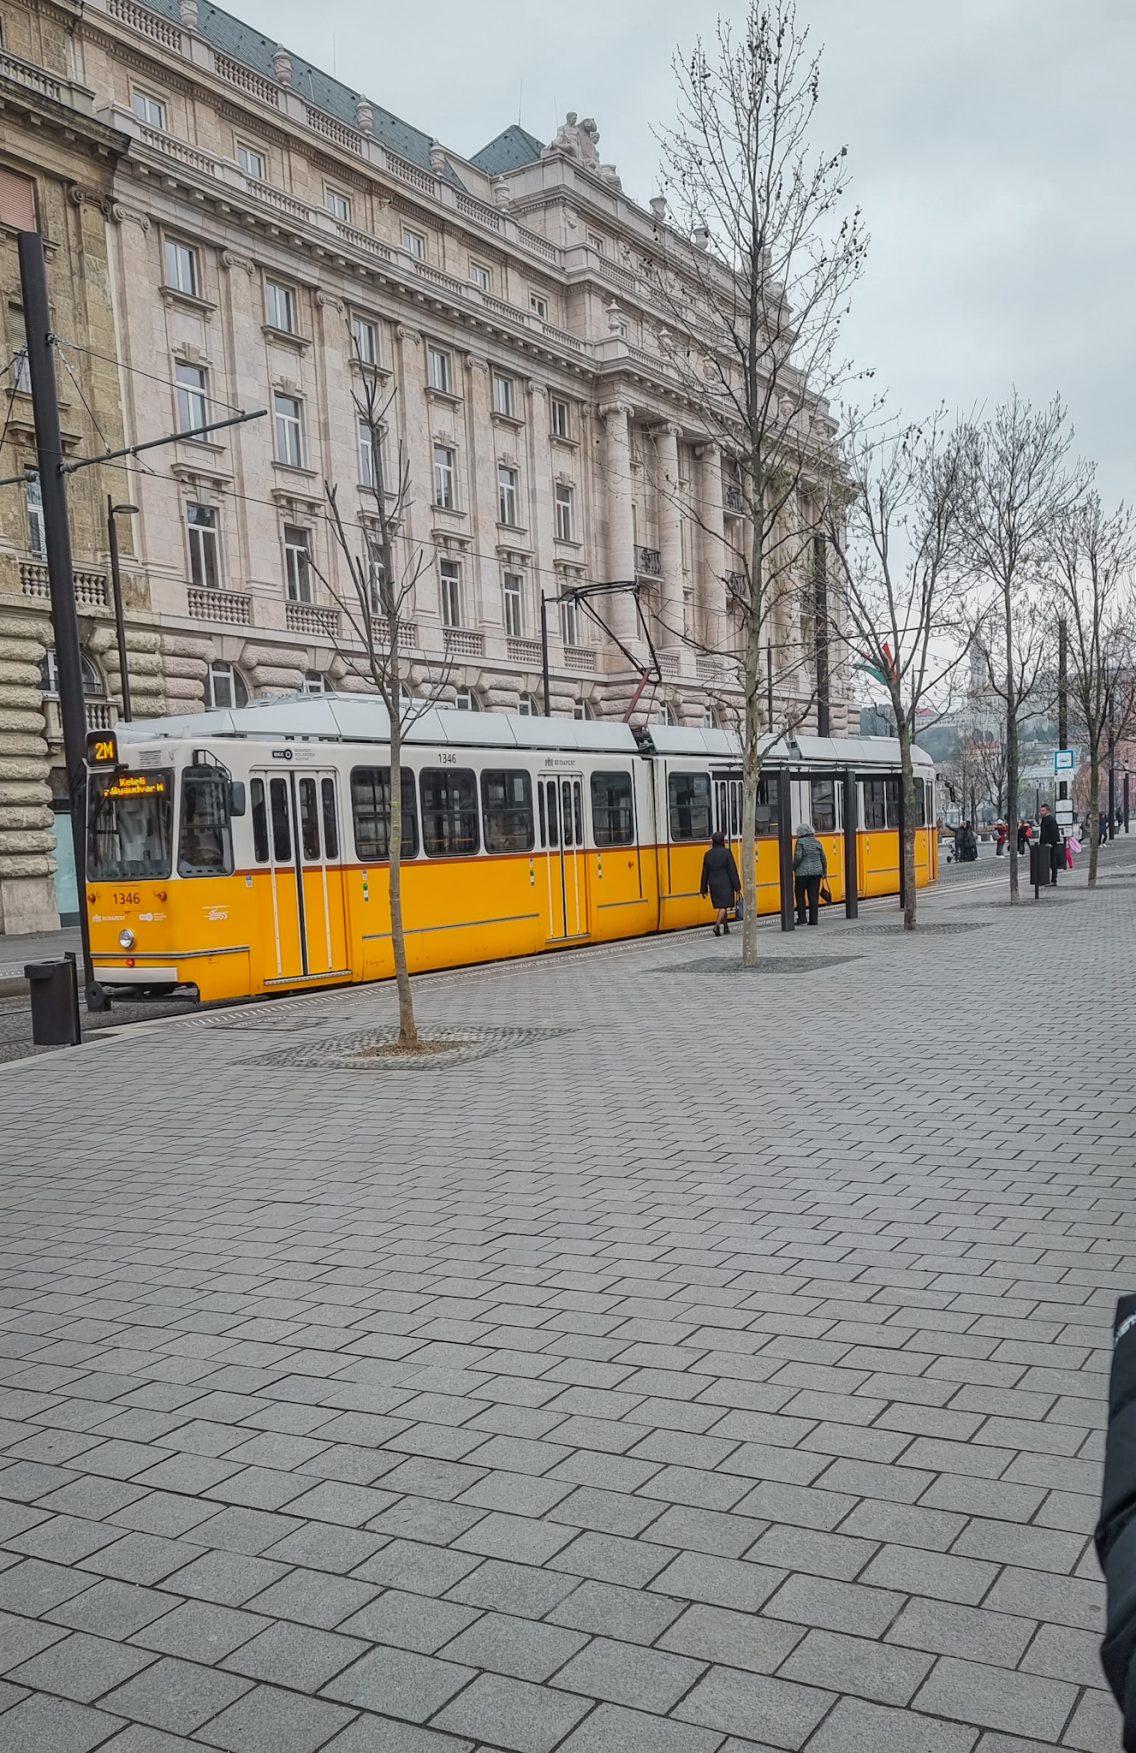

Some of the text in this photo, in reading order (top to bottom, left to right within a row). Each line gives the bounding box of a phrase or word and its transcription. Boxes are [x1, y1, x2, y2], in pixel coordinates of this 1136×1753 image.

[95, 741, 114, 760] 2M
[436, 753, 457, 764] 1346
[113, 892, 141, 905] 1346
